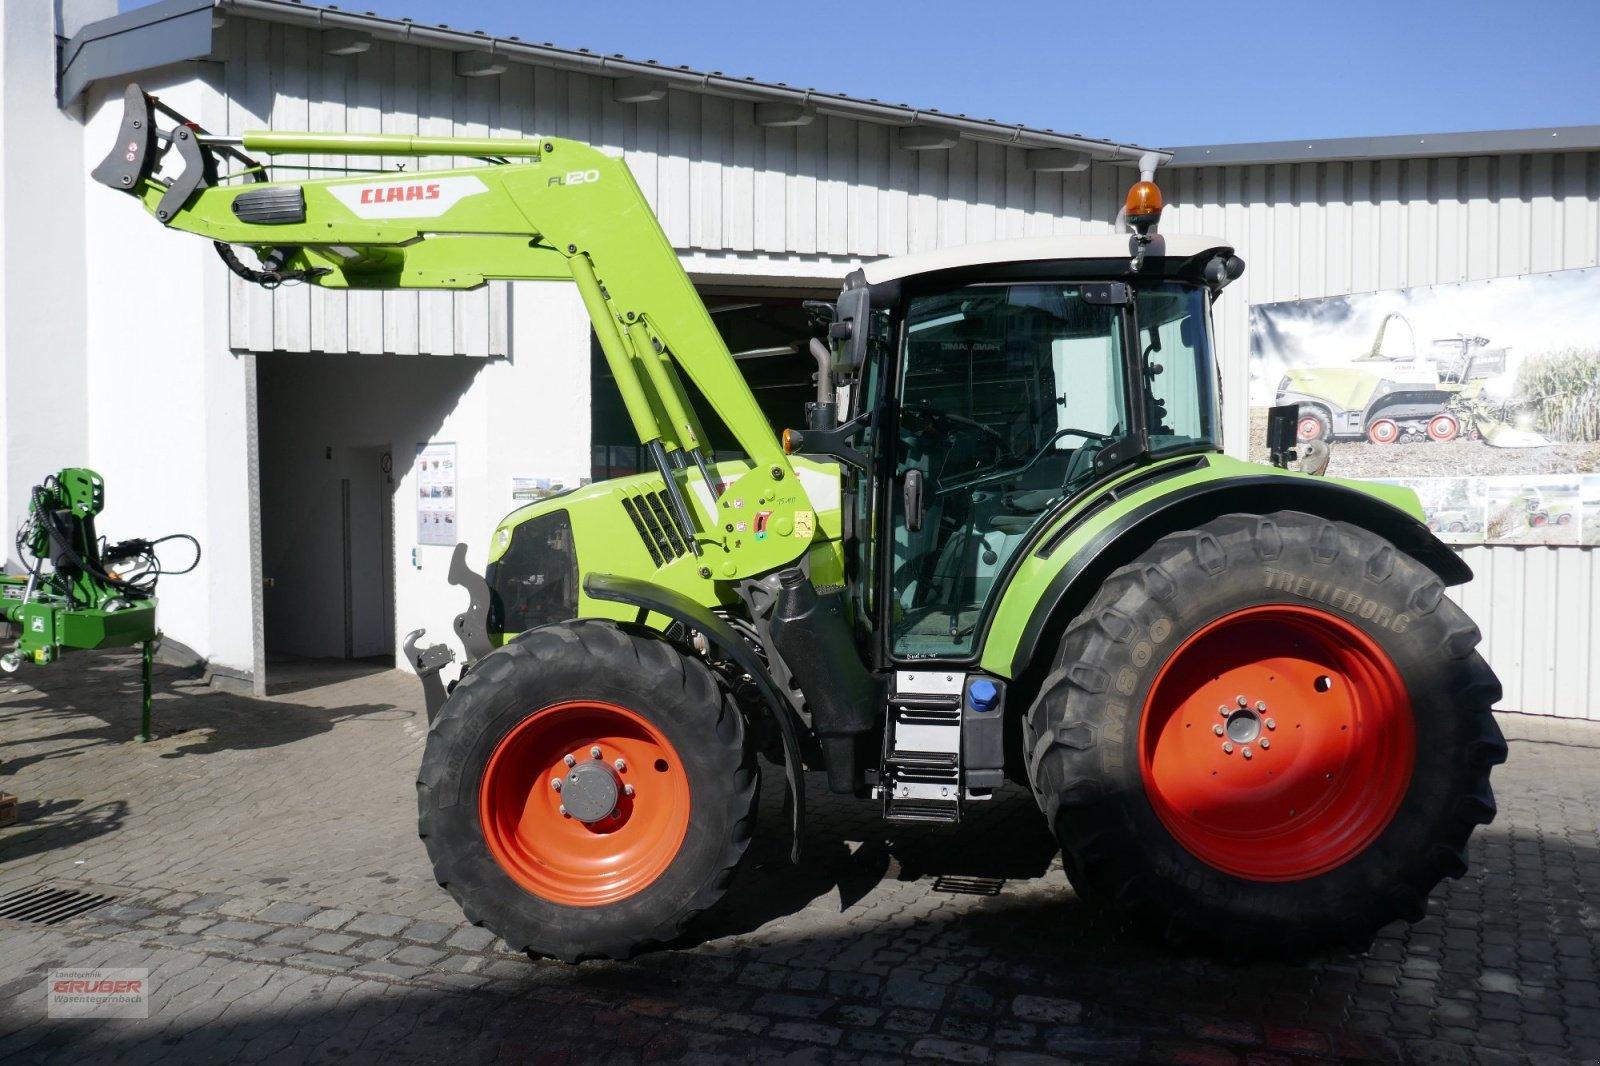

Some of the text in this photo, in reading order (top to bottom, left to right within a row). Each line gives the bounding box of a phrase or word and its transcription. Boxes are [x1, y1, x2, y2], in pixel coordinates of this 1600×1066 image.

[548, 169, 600, 188] FL120
[360, 184, 440, 204] CLAAS
[1263, 567, 1410, 633] TRELLEBORG
